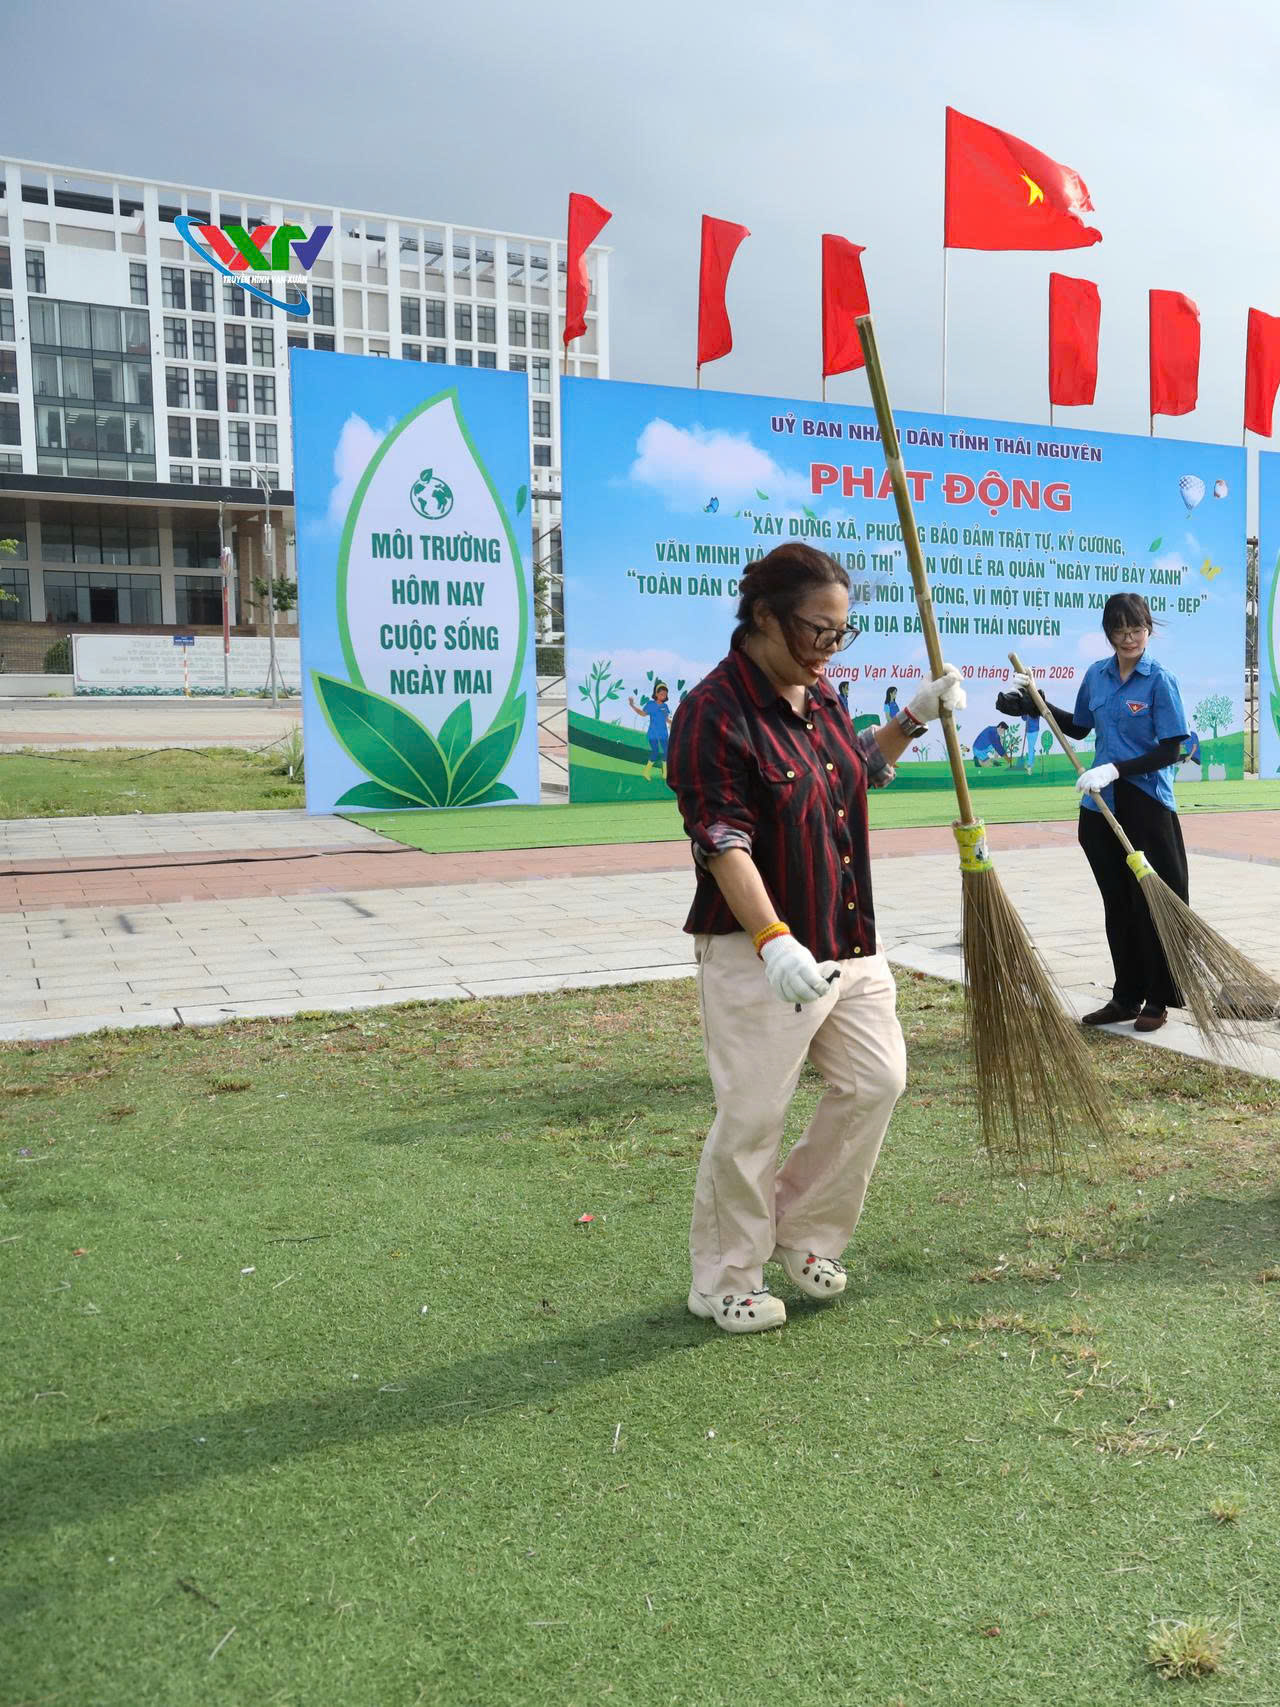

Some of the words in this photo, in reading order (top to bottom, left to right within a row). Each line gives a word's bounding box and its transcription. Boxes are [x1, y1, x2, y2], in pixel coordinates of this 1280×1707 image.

[771, 412, 796, 434] UỶ
[803, 420, 842, 438] BAN
[907, 428, 943, 447] DÂN
[949, 430, 989, 451] TỈNH
[994, 437, 1031, 455] THÁI
[1037, 443, 1102, 462] NGUYÊN
[942, 471, 1071, 517] ĐỘNG
[371, 528, 413, 561] MÔI
[420, 529, 501, 564] TRƯỜNG
[789, 517, 832, 541] DỰNG
[837, 518, 861, 541] XÃ,
[930, 522, 958, 544] BẢO
[963, 525, 994, 547] ĐẢM
[998, 529, 1031, 552] TRẬT
[1058, 530, 1075, 551] KỶ
[1079, 535, 1125, 556] CƯƠNG,
[656, 540, 690, 562] VĂN
[696, 545, 740, 565] MINH
[846, 549, 866, 570] ĐÔ
[940, 554, 963, 575] VỚI
[967, 552, 983, 576] LỄ
[987, 559, 1005, 576] RA
[1009, 559, 1045, 578] QUÂN
[1095, 564, 1120, 582] THỨ
[1122, 562, 1145, 583] BẢY
[391, 573, 440, 606] HÔM
[446, 581, 485, 606] NAY
[688, 574, 722, 597] DÂN
[853, 581, 871, 605] VỆ
[876, 582, 904, 603] MÔI
[973, 584, 986, 605] VÌ
[990, 587, 1019, 609] MỘT
[1023, 588, 1050, 611] VIỆT
[1054, 591, 1084, 609] NAM
[380, 619, 437, 655] CUỘC
[444, 616, 499, 651] SỐNG
[874, 615, 899, 637] ĐỊA
[903, 612, 922, 633] BÀ
[937, 611, 969, 634] TỈNH
[973, 614, 1003, 635] THÁI
[1008, 616, 1061, 636] NGUYÊN
[390, 663, 447, 695] NGÀY
[453, 668, 493, 694] MAI
[864, 665, 886, 681] Vạn
[961, 665, 974, 678] 30
[977, 664, 1010, 681] tháng
[1049, 666, 1074, 679] 2026
